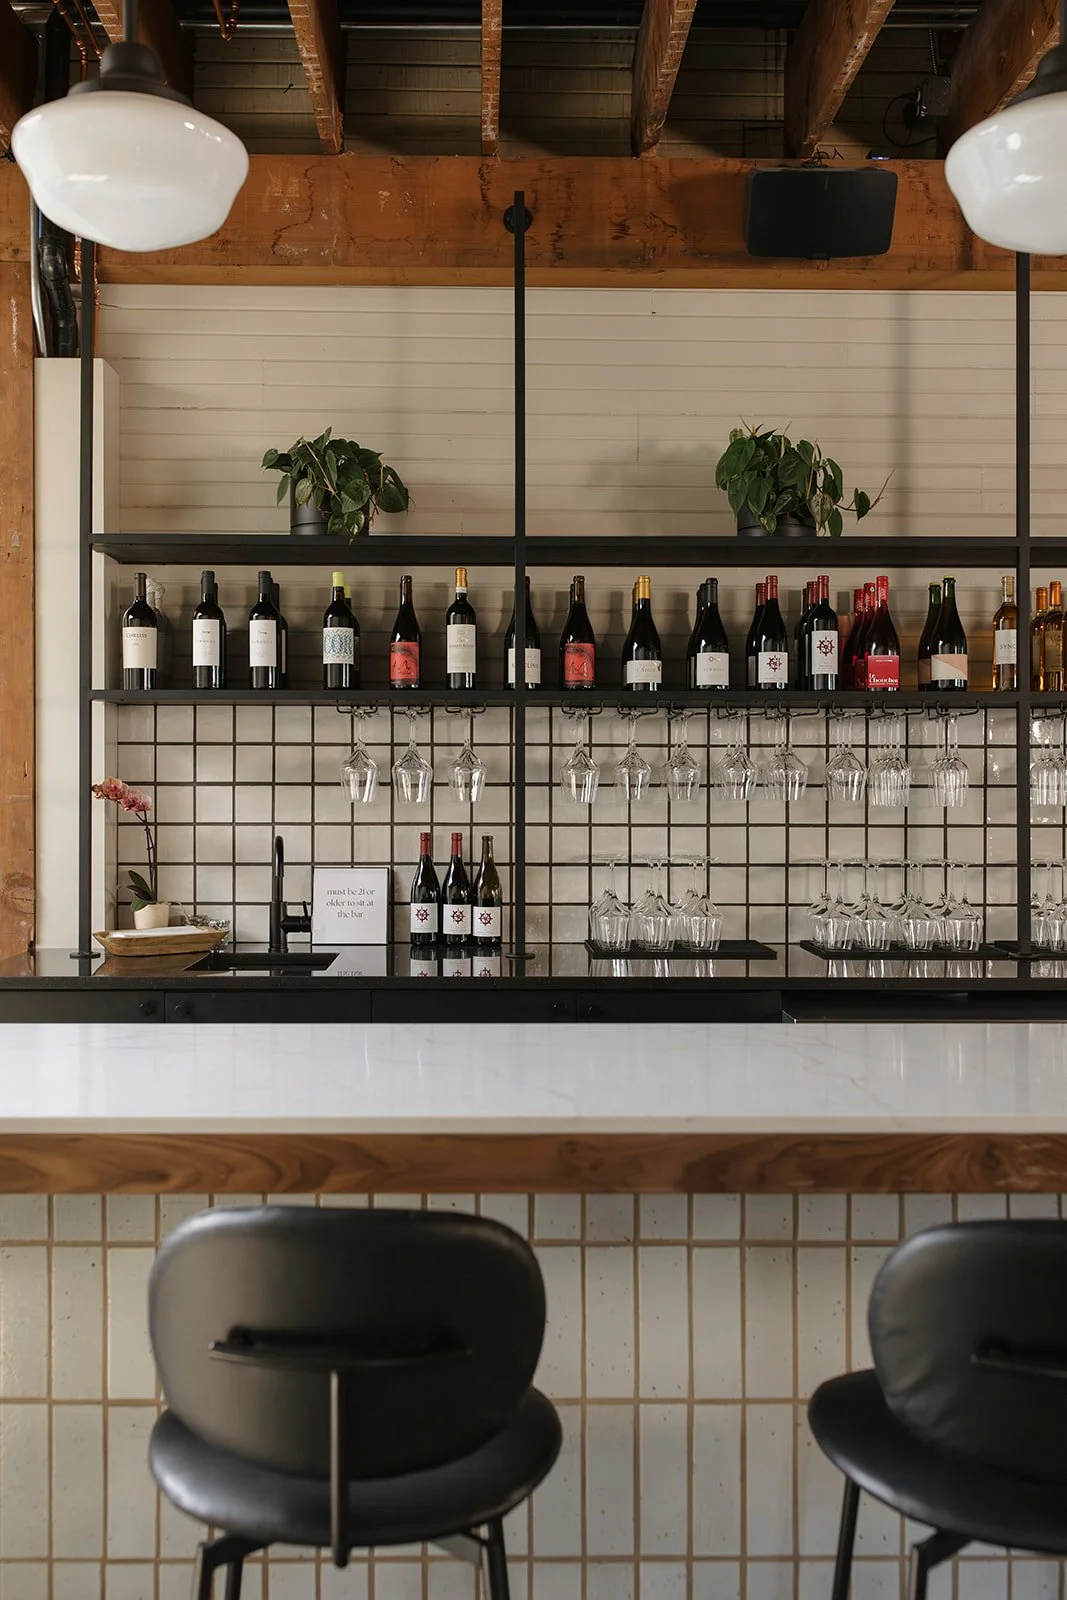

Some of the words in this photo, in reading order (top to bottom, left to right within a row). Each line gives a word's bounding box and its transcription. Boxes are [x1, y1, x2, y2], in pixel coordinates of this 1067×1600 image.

[348, 888, 357, 896] be
[358, 888, 366, 896] 21
[326, 899, 346, 907] older
[351, 910, 364, 918] bar
